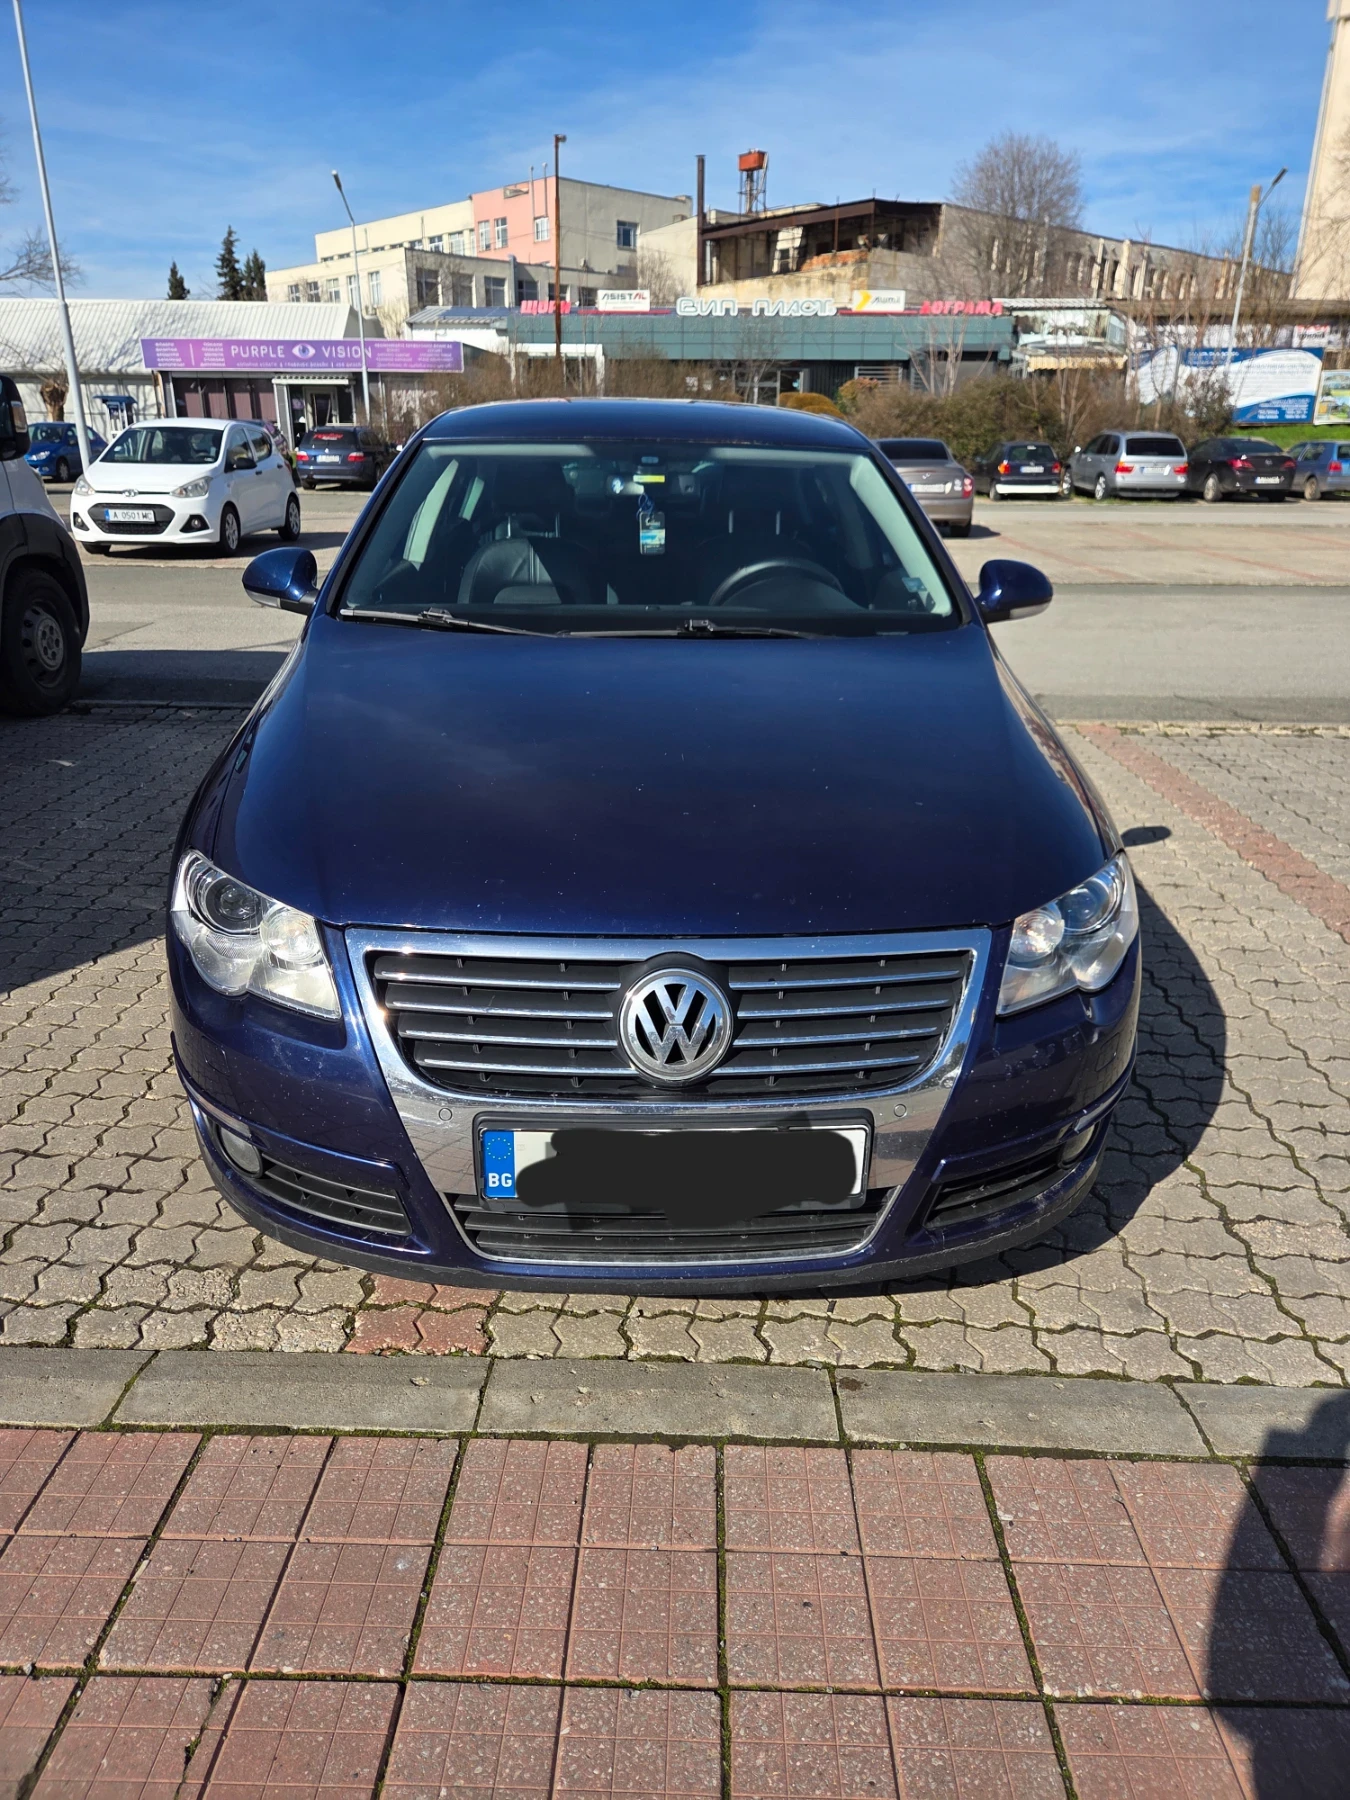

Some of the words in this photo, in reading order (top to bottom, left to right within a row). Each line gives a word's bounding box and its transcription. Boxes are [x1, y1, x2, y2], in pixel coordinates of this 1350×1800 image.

[602, 292, 647, 300] ASISTAL
[676, 297, 738, 316] ВИП
[231, 345, 286, 358] PURPLE
[321, 345, 372, 359] VISION
[488, 1172, 513, 1188] BG
